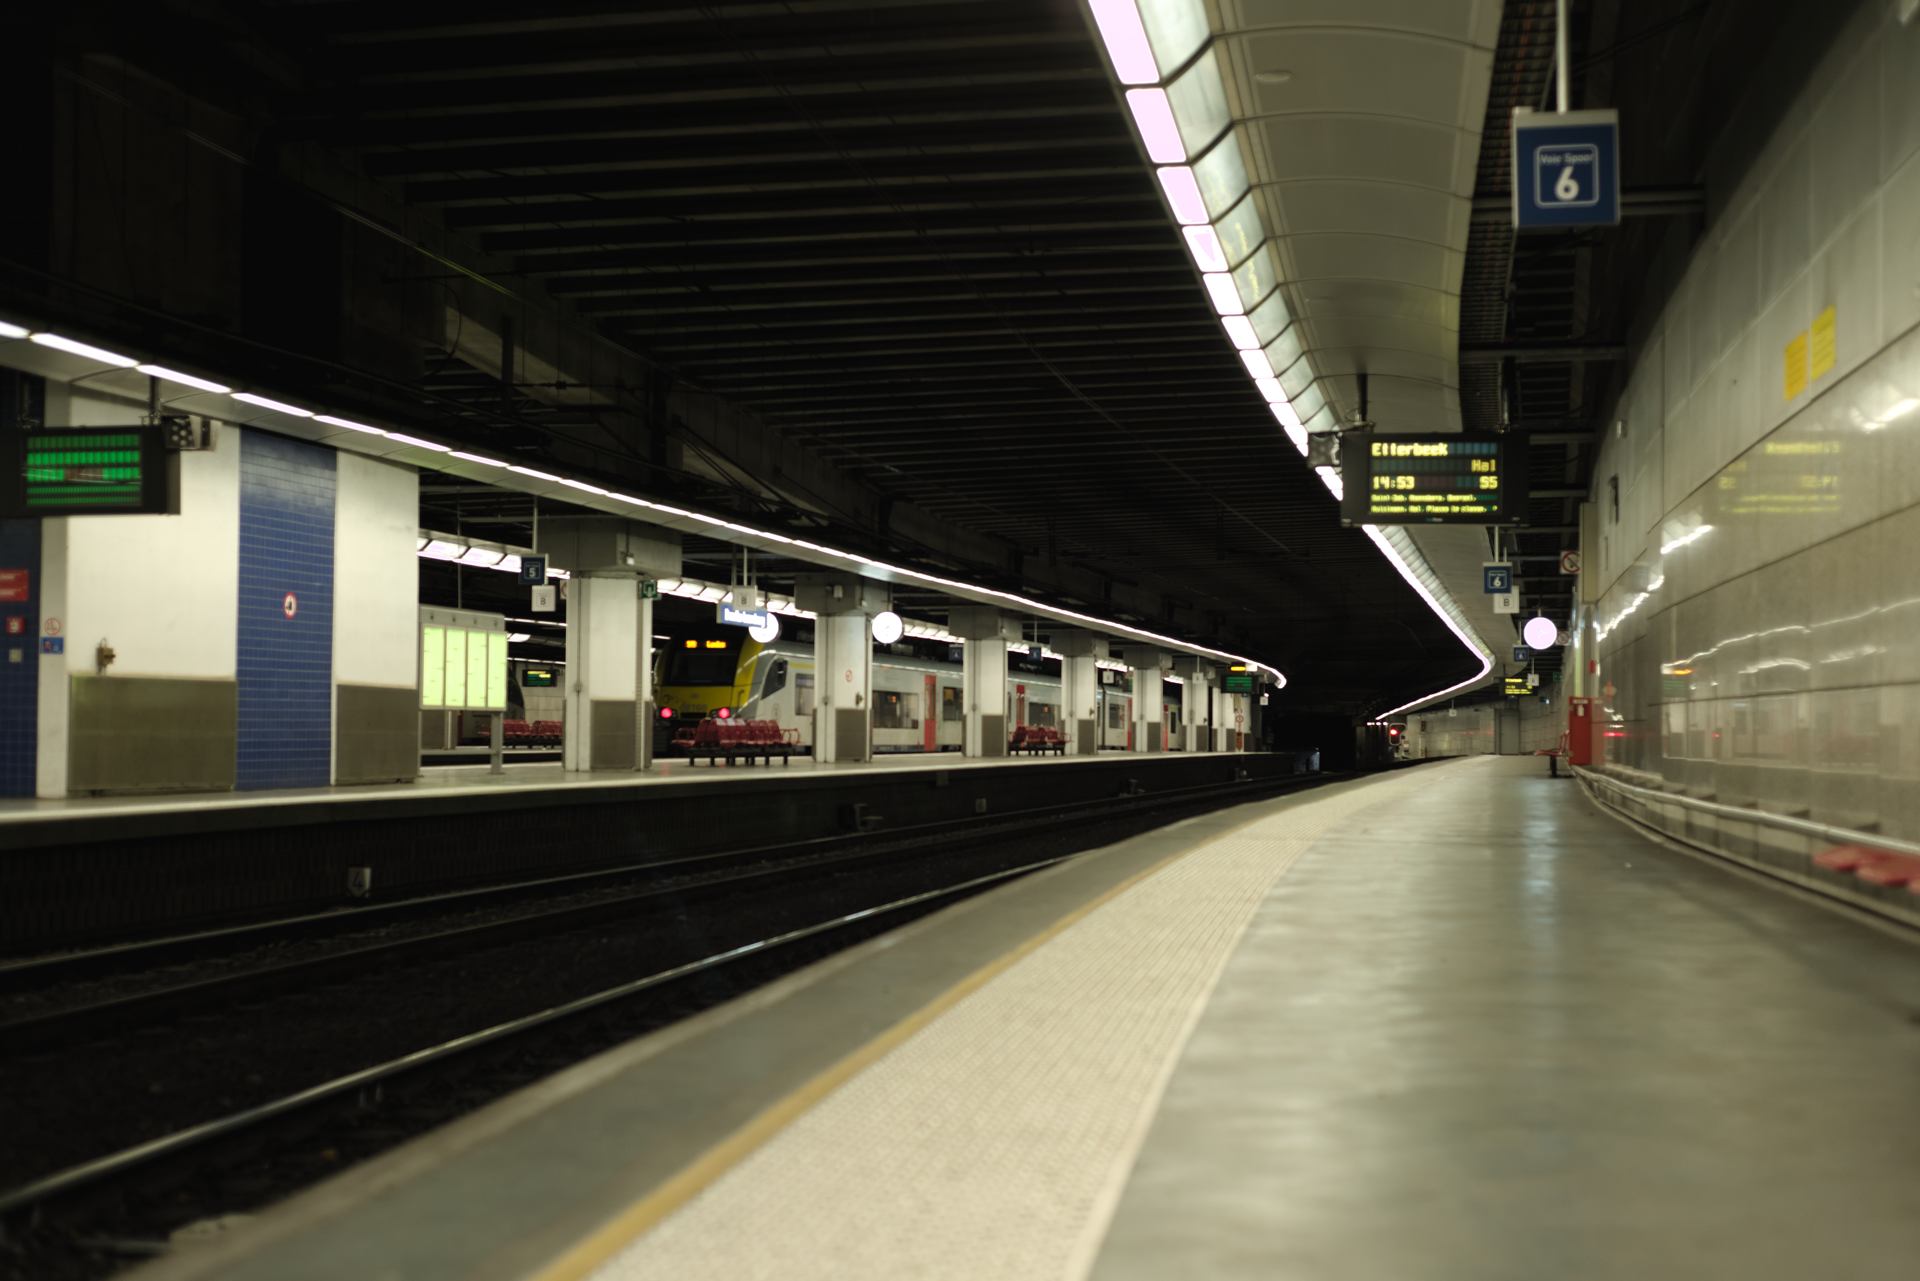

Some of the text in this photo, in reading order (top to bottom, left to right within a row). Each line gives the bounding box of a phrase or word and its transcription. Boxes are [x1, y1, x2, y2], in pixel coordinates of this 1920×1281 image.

[1555, 166, 1579, 201] 6
[1372, 442, 1448, 456] Etterbeek
[1471, 460, 1496, 472] Hal
[1373, 476, 1415, 489] 14:53
[528, 567, 536, 578] 5
[1493, 577, 1502, 587] 6
[540, 597, 546, 605] B
[1503, 598, 1510, 607] B
